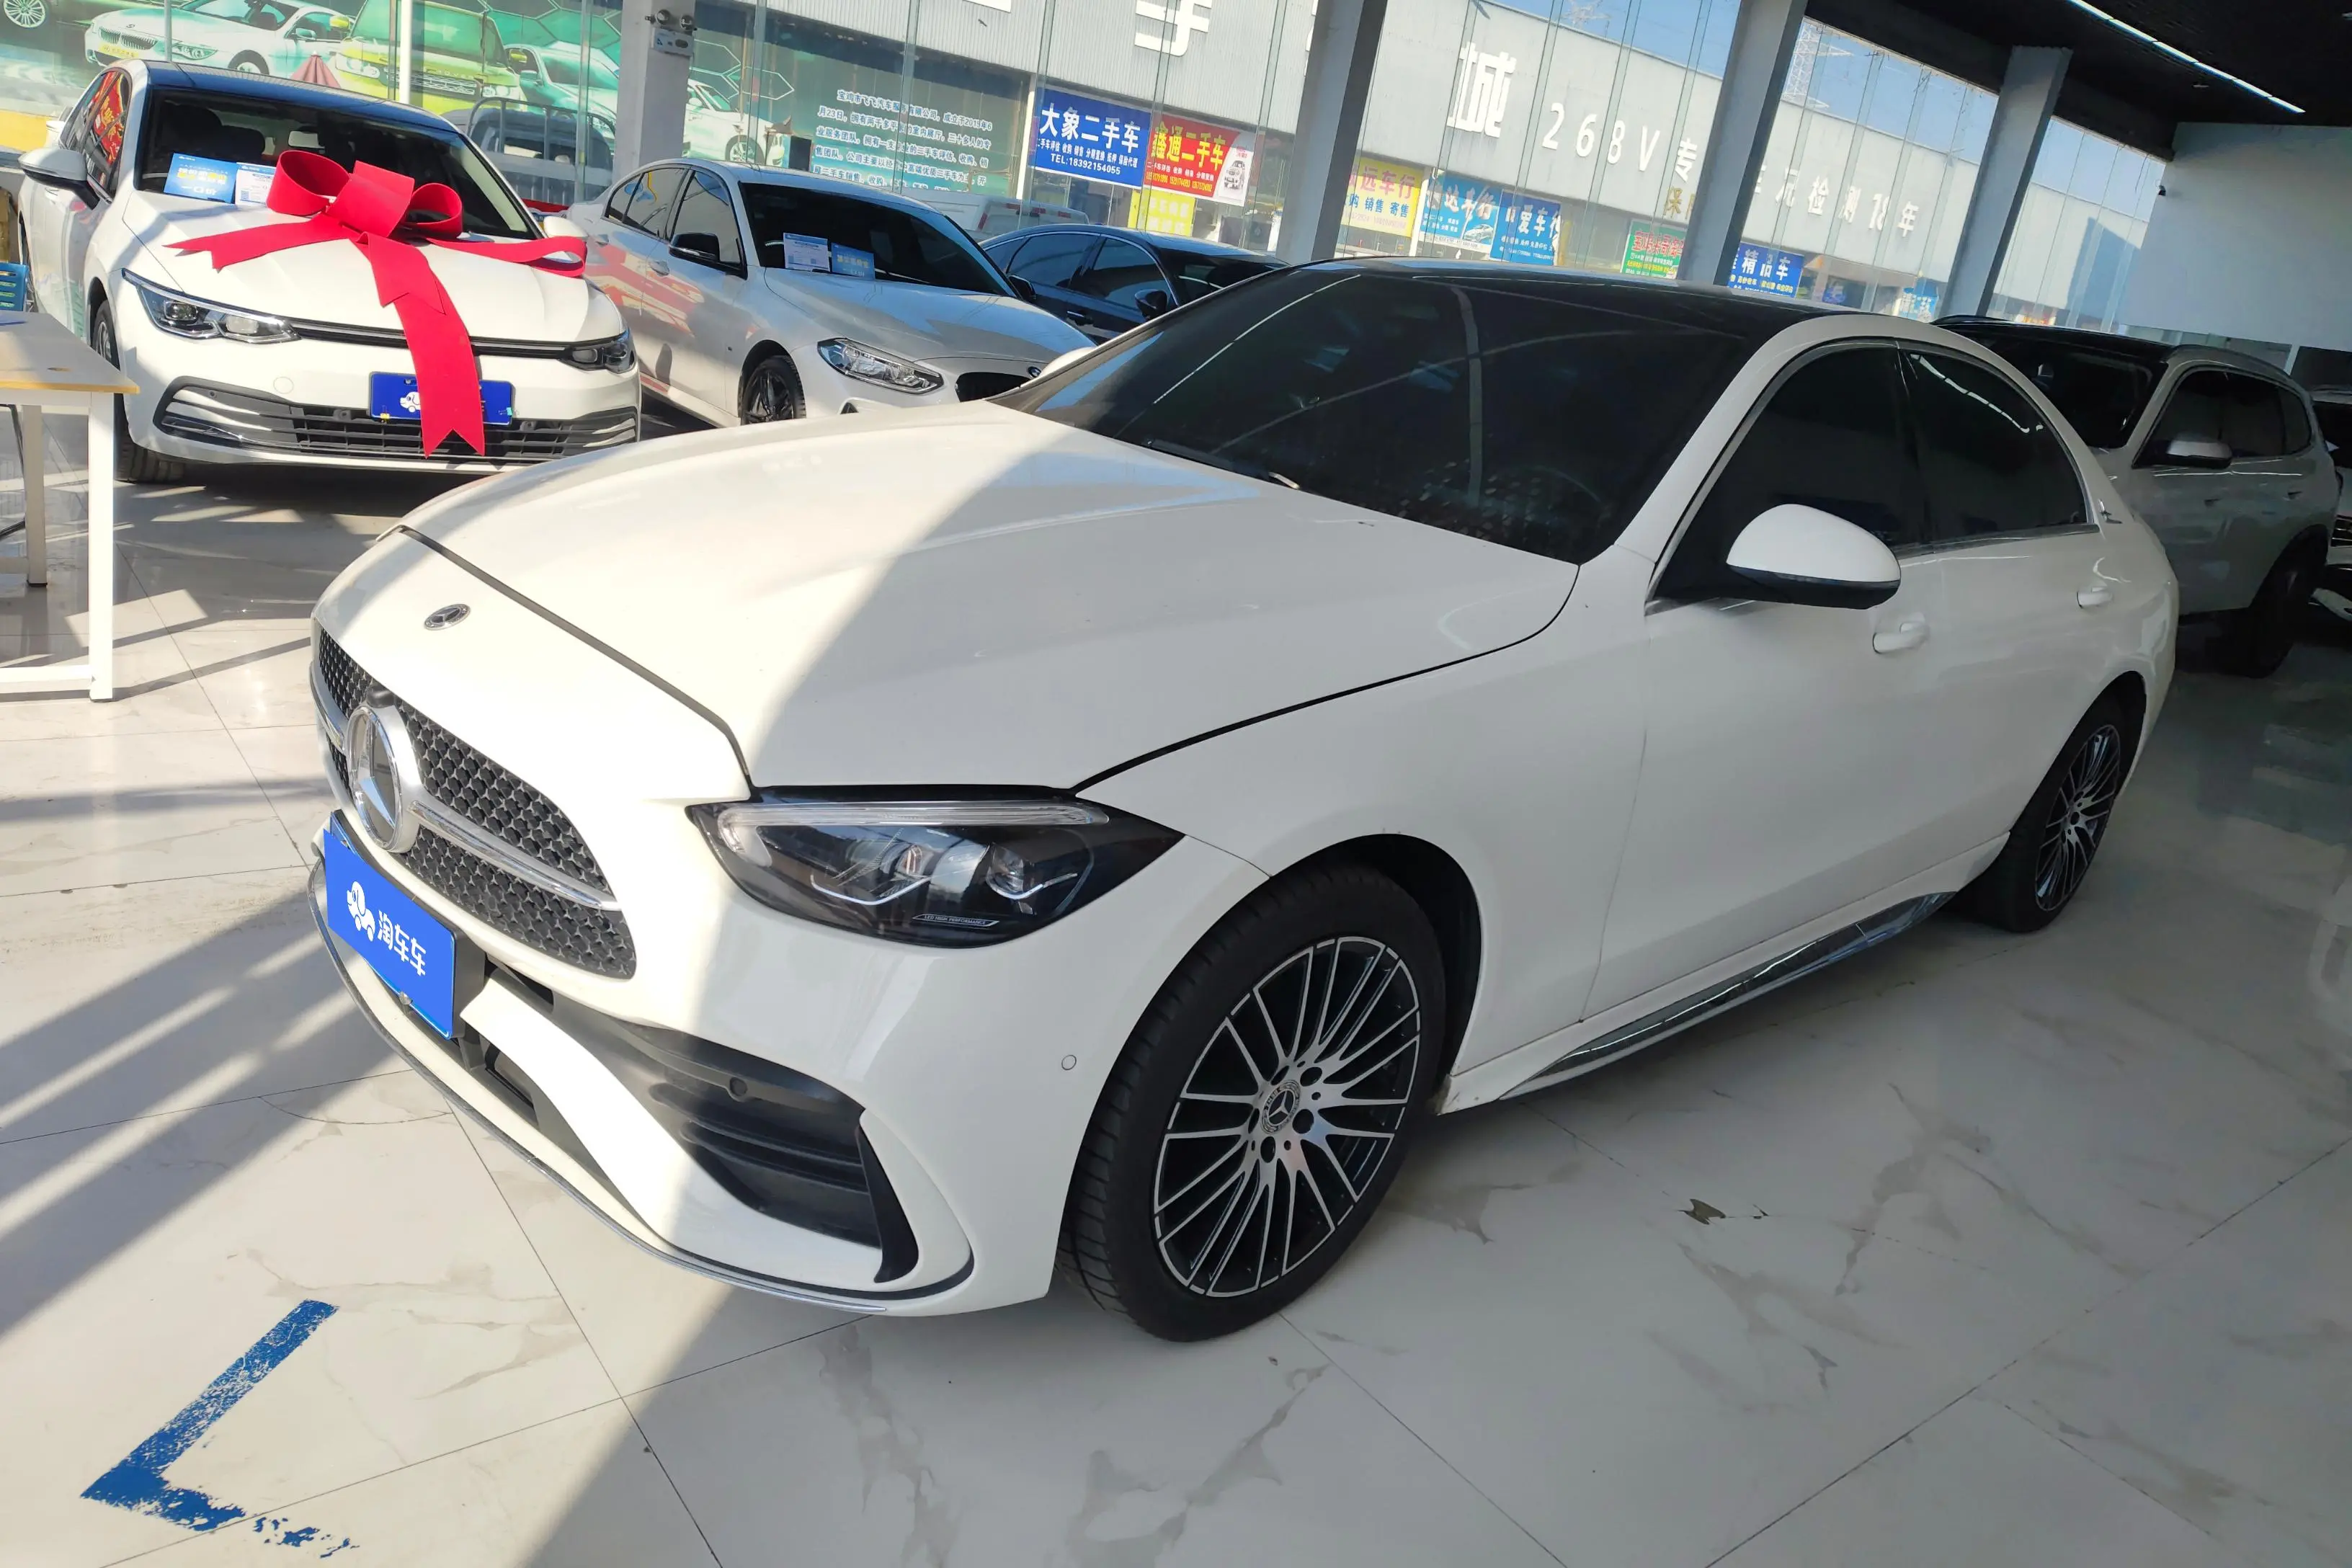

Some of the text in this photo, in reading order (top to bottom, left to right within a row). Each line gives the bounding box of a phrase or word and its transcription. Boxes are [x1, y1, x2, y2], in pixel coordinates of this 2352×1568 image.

[1446, 40, 1517, 138] 城
[1039, 102, 1141, 153] 大象二手车
[1151, 120, 1226, 172] 鑫通二手车
[1051, 153, 1121, 175] TEL:18392154055
[1365, 197, 1384, 213] 销售
[1390, 202, 1409, 218] 寄售
